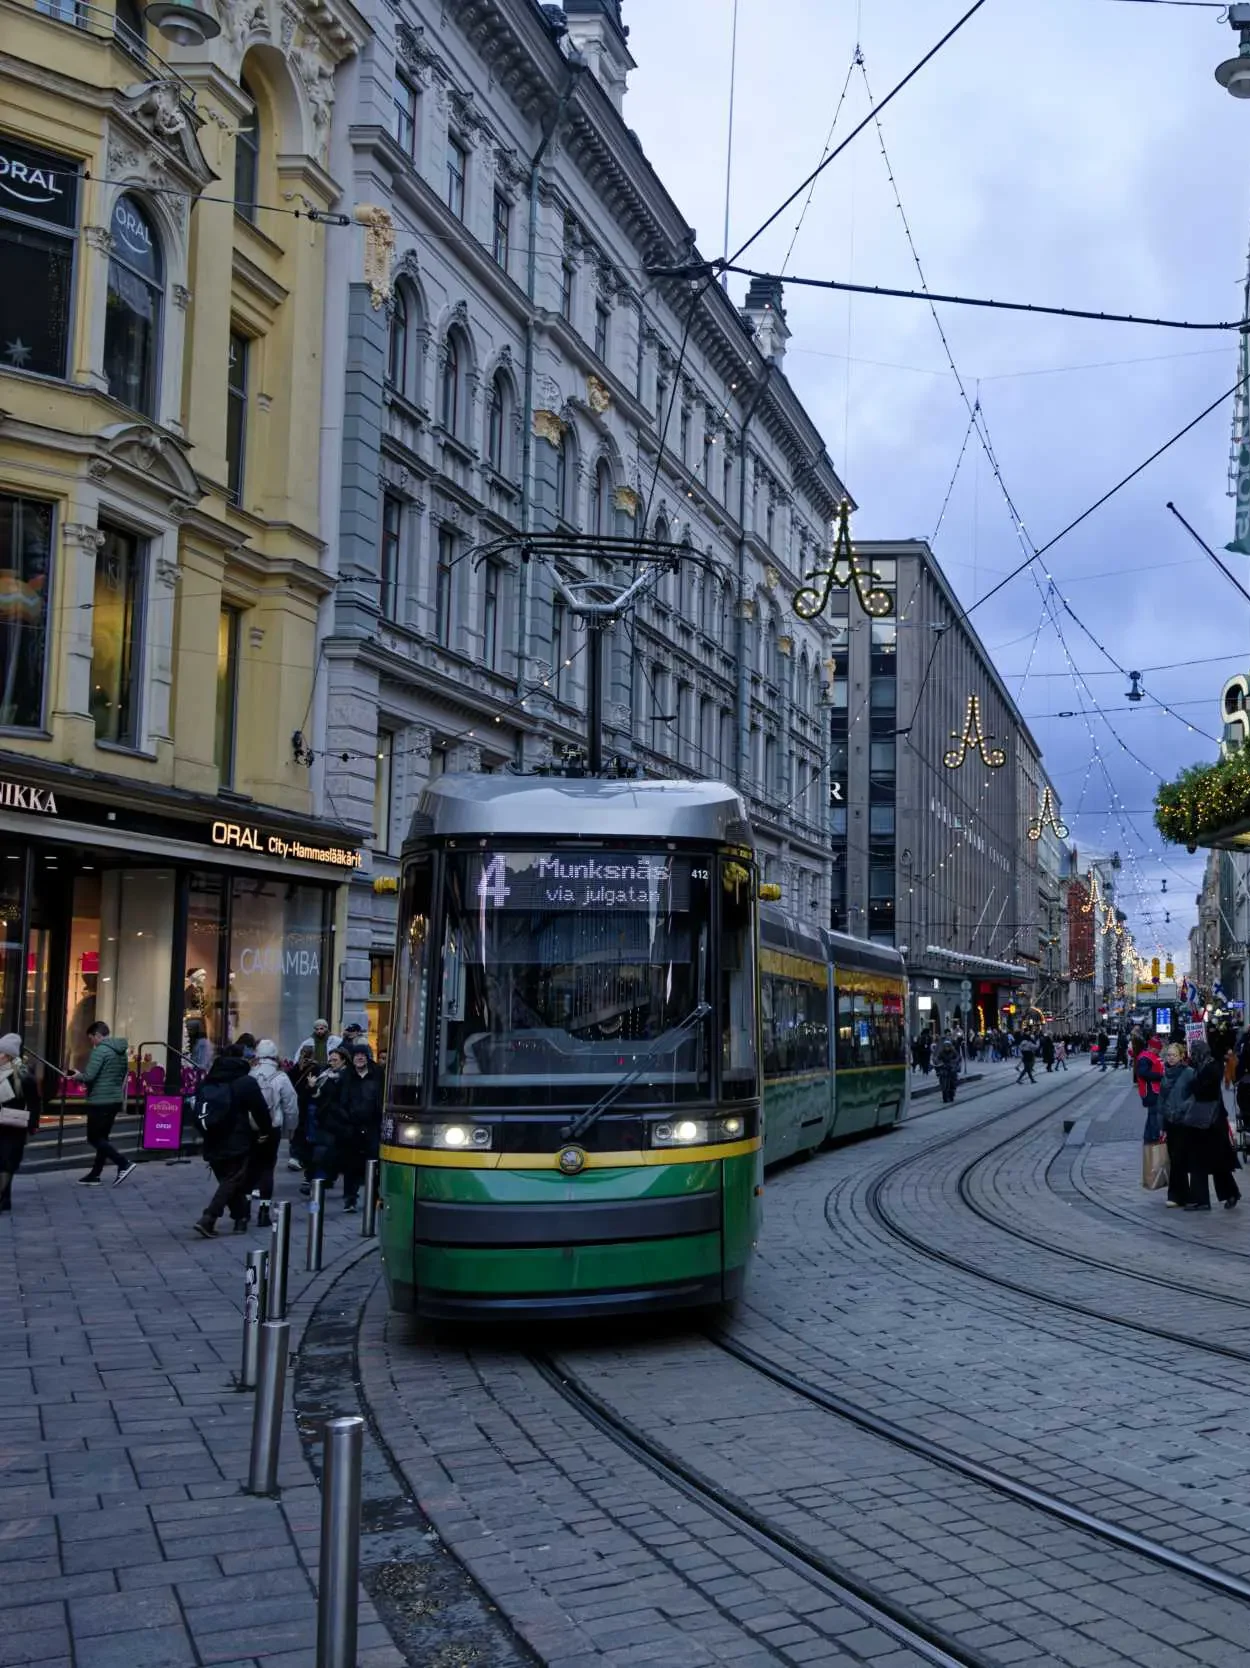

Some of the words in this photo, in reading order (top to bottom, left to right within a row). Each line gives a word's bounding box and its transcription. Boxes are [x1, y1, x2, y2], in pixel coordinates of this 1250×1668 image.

[115, 206, 153, 247] ORAL
[0, 781, 58, 815] IKKA
[212, 821, 264, 851] ORAL
[477, 855, 511, 907] 4
[690, 869, 709, 880] 412
[546, 886, 575, 901] via
[582, 885, 660, 906] julgatan
